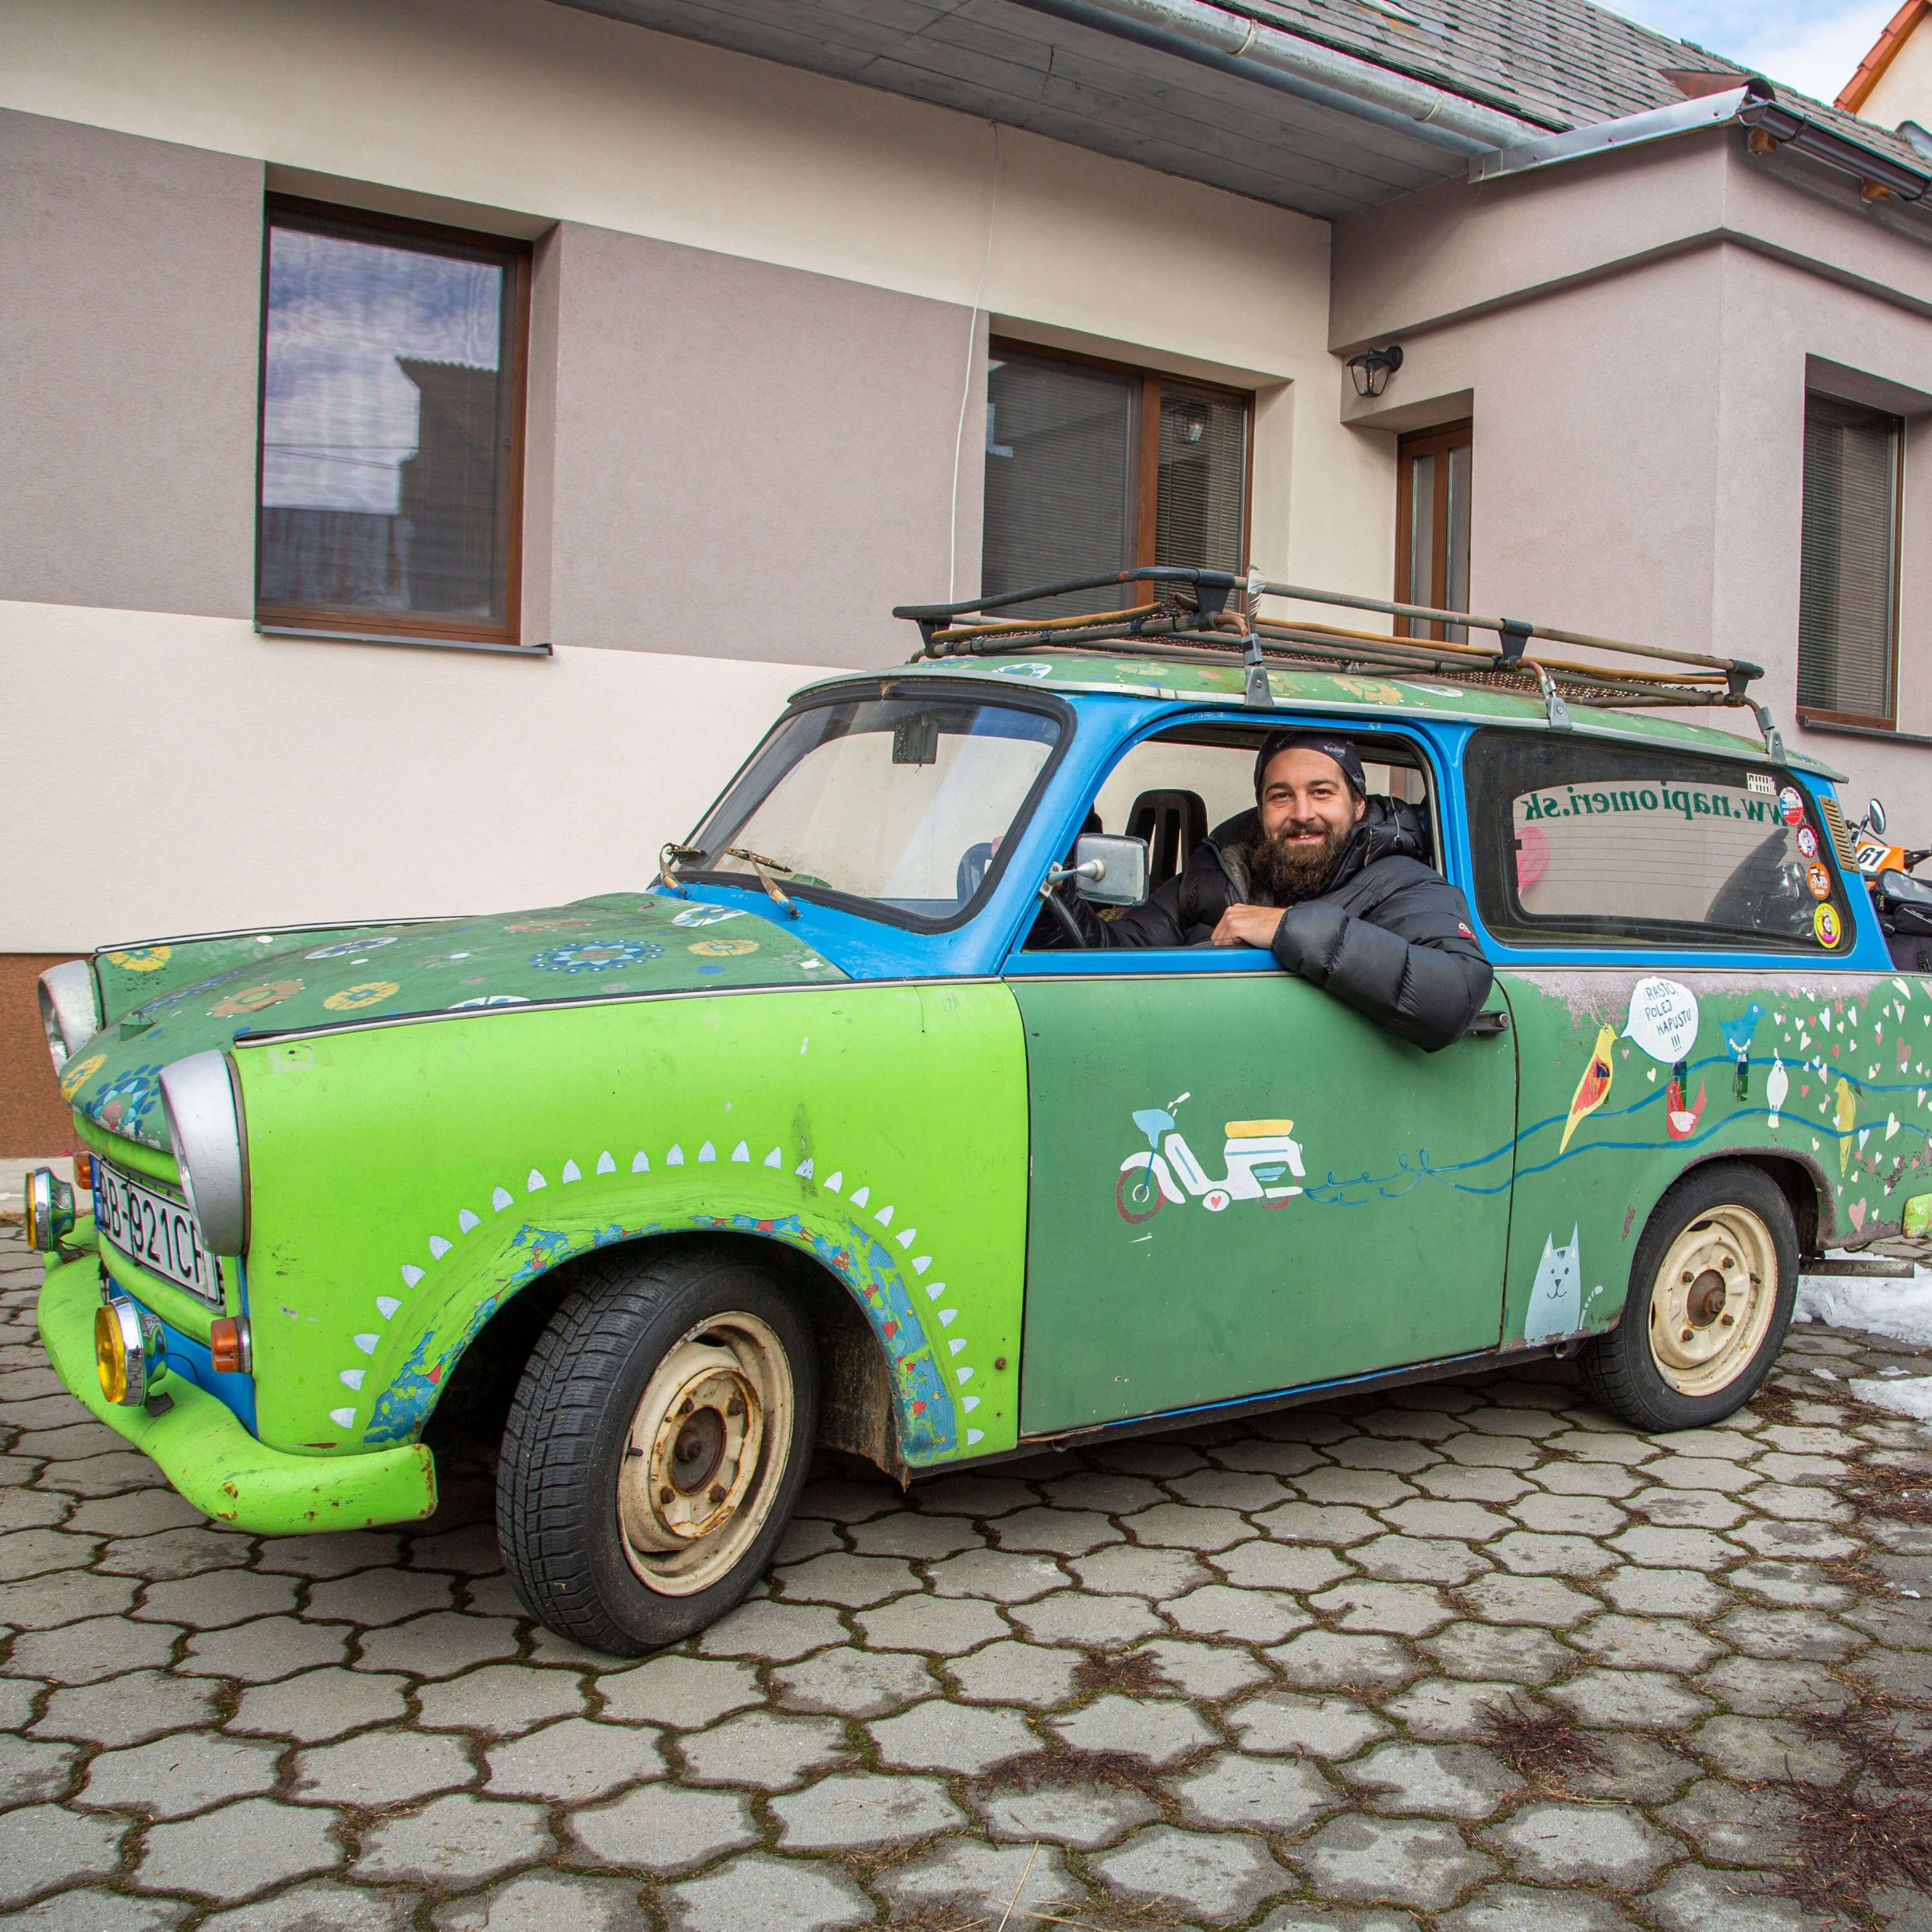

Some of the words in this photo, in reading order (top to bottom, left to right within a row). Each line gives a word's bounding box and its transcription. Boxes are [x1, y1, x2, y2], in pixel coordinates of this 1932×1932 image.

[1857, 848, 1885, 866] 61
[1645, 999, 1672, 1021] POLEJ
[1656, 1008, 1691, 1036] KAPUSTU
